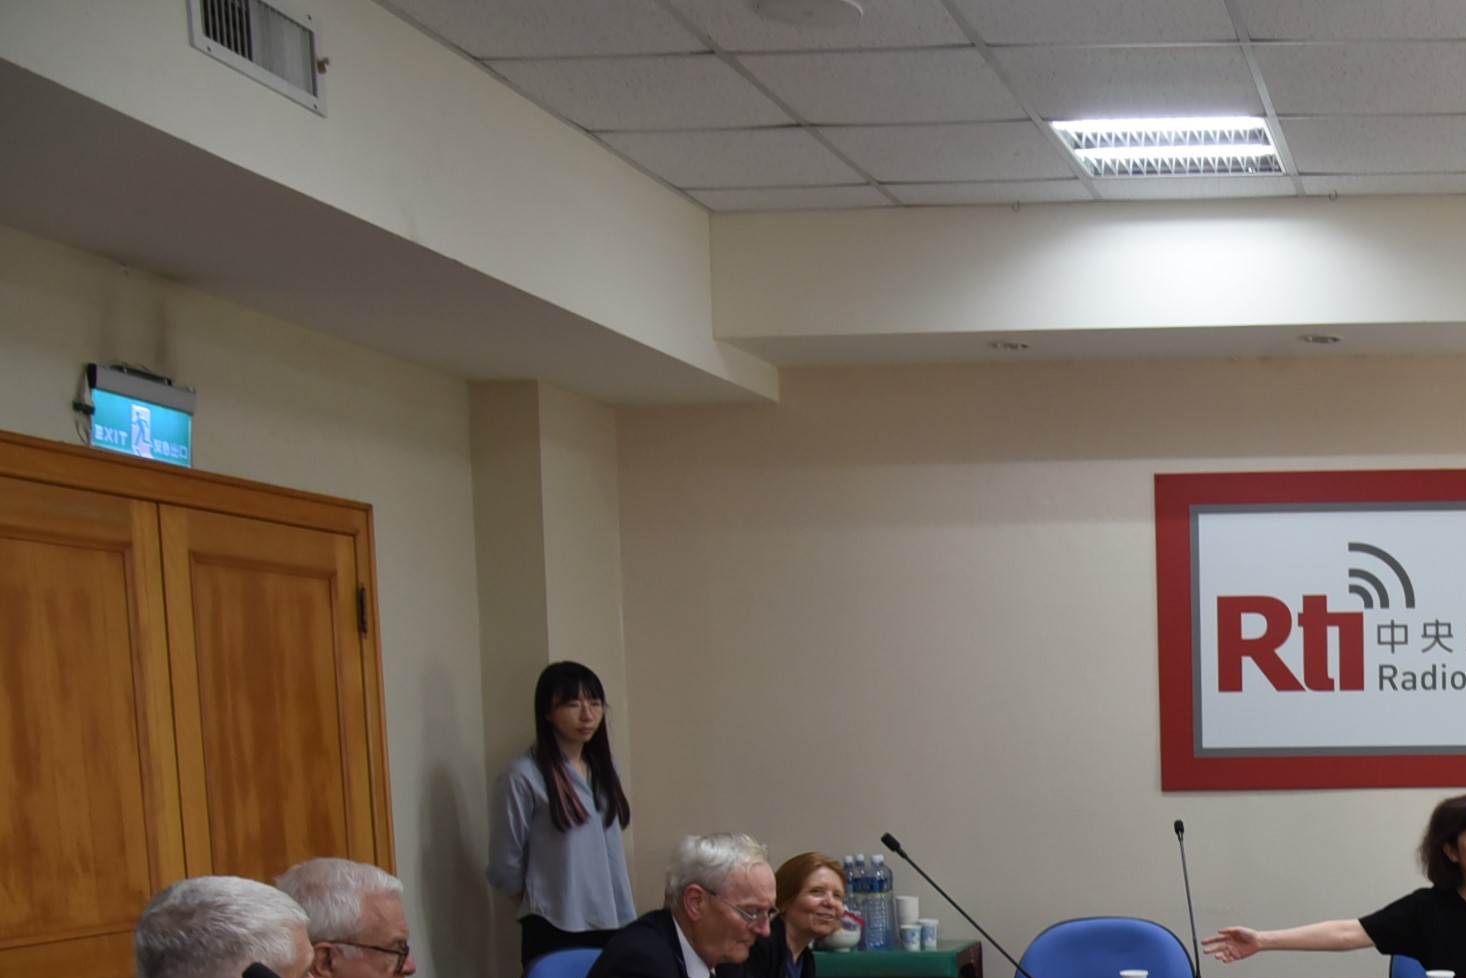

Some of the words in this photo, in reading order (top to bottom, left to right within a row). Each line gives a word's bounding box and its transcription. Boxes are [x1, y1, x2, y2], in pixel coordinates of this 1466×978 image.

[94, 424, 128, 446] EXIT
[1217, 594, 1364, 692] Rti
[1378, 663, 1466, 691] Radio
